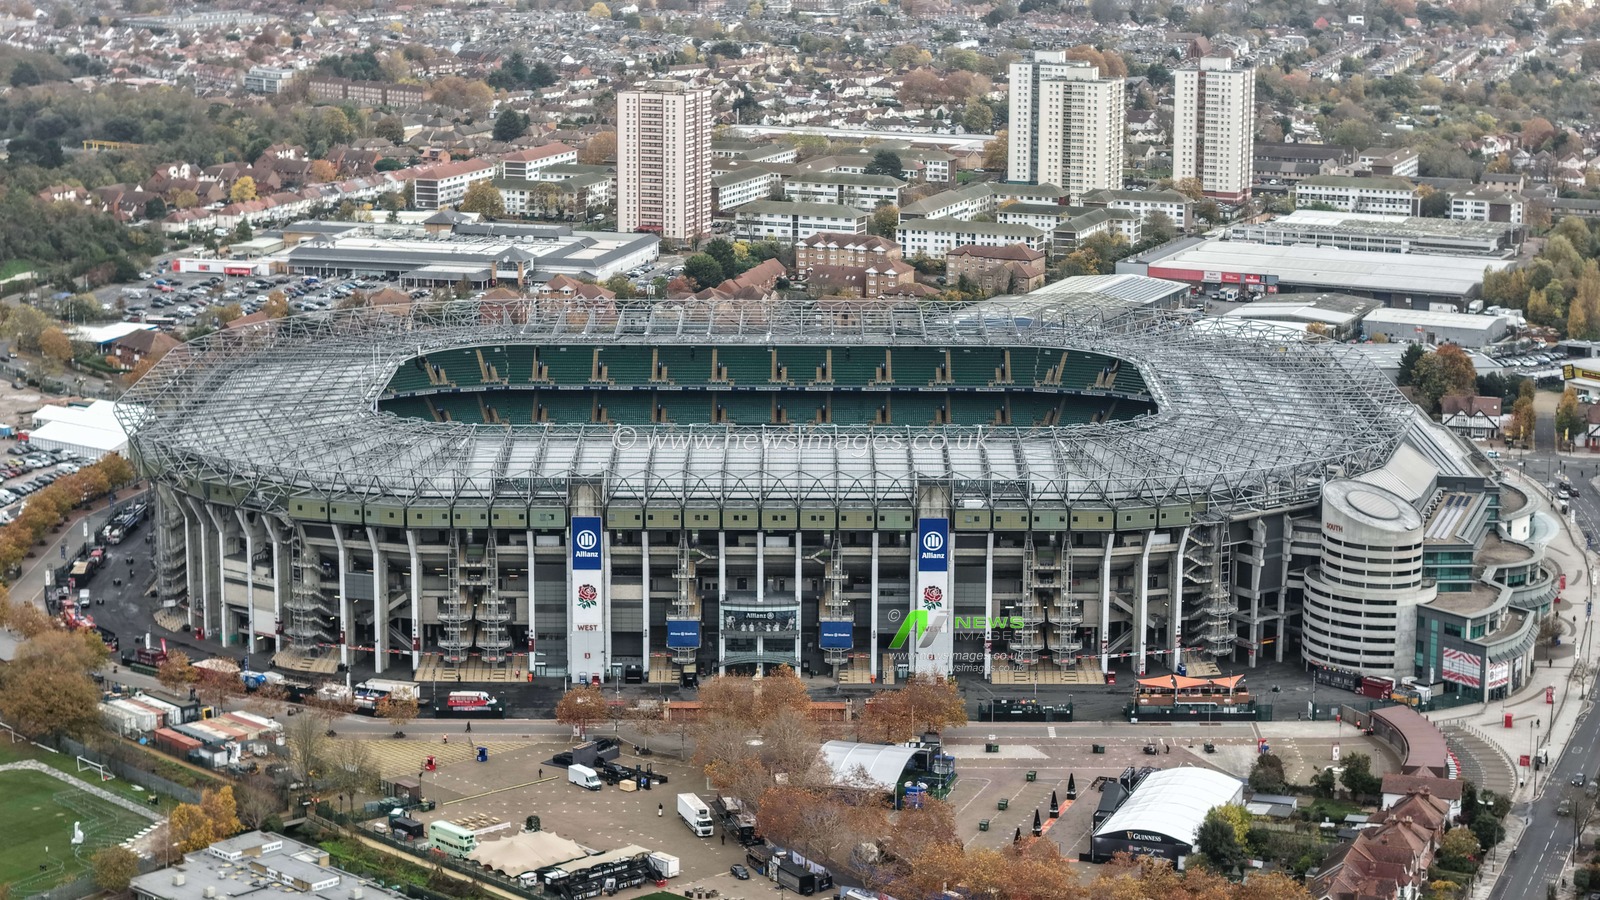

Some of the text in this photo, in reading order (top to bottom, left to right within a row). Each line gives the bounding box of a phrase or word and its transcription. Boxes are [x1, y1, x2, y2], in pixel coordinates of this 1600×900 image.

[1326, 522, 1343, 533] SOUTH
[575, 550, 599, 558] Allianz
[1133, 833, 1162, 842] GUINNESS
